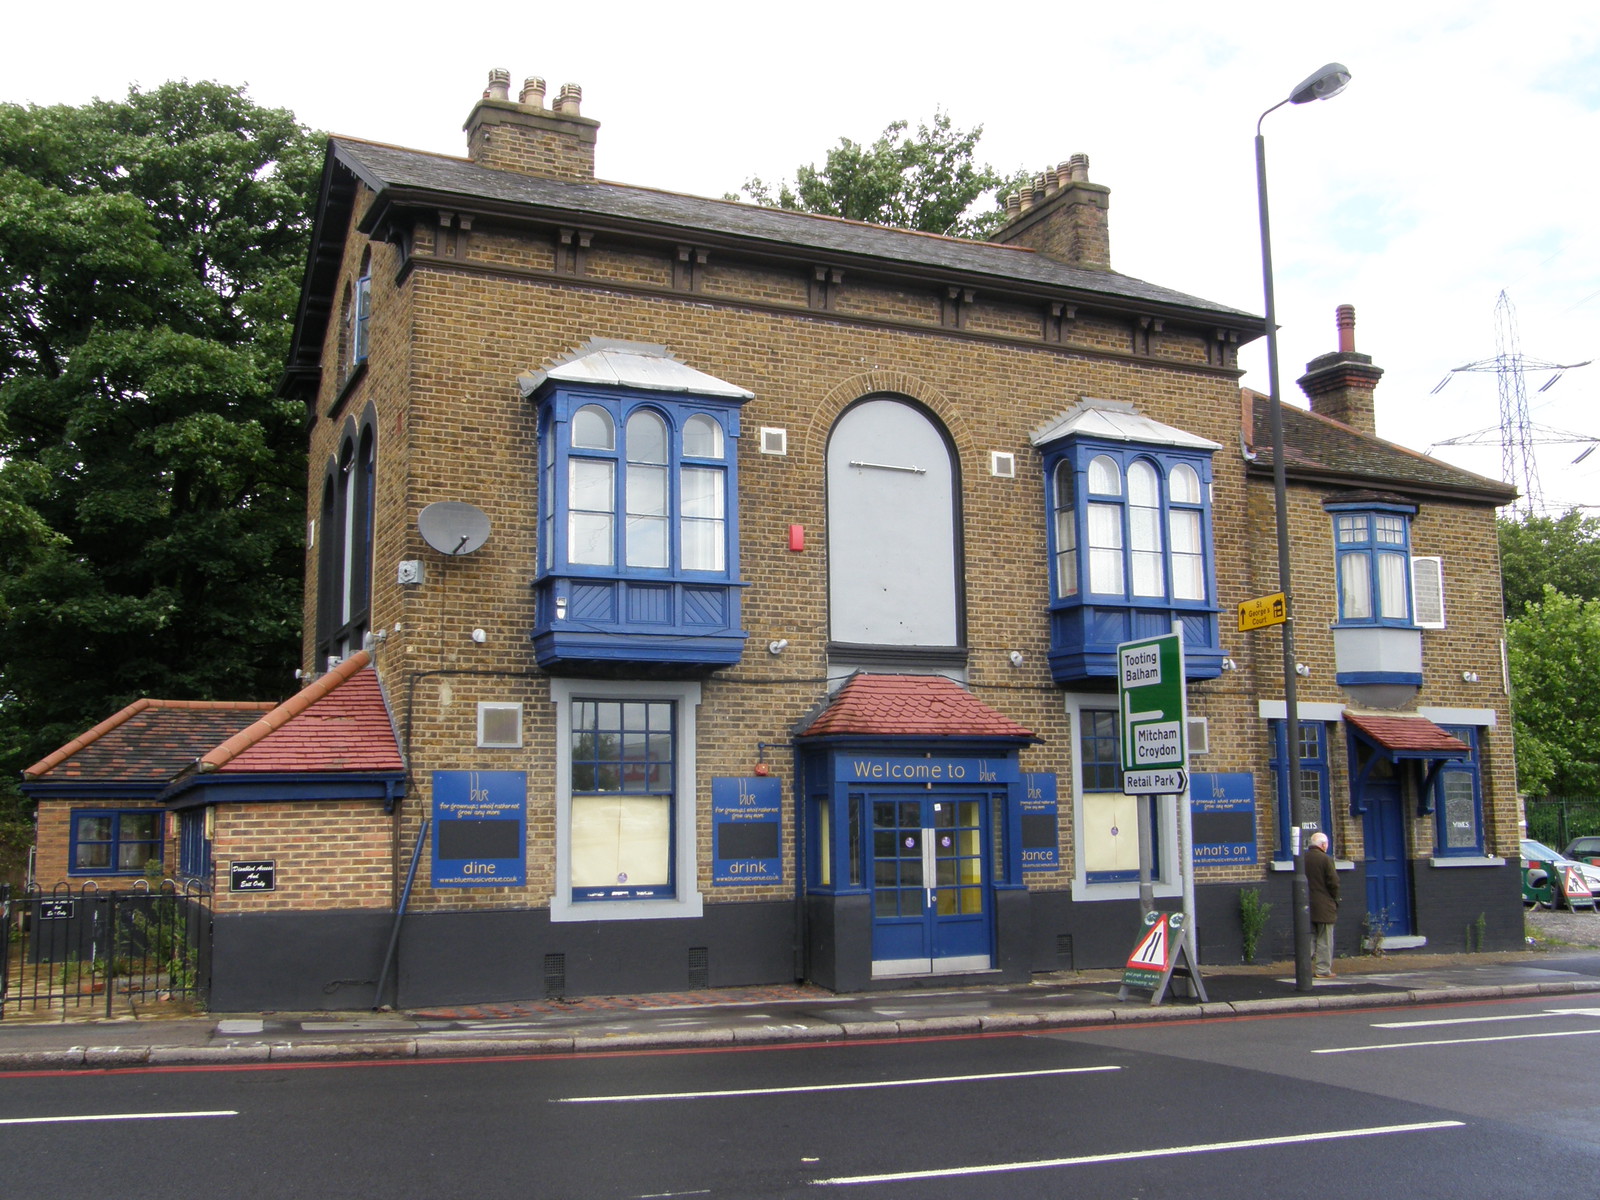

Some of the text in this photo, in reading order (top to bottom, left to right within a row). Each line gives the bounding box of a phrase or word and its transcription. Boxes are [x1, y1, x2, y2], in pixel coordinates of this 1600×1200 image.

[1248, 607, 1270, 617] George's
[1252, 617, 1267, 625] Court
[1125, 652, 1157, 666] Tooting
[1126, 668, 1158, 682] Balham
[1138, 728, 1177, 742] Mitcham
[1138, 745, 1177, 759] Croydon
[854, 761, 942, 778] Welcome
[948, 763, 966, 778] to
[1127, 774, 1175, 788] Retail Park
[1194, 845, 1247, 856] what's on
[463, 862, 496, 874] dine
[729, 861, 767, 873] drink
